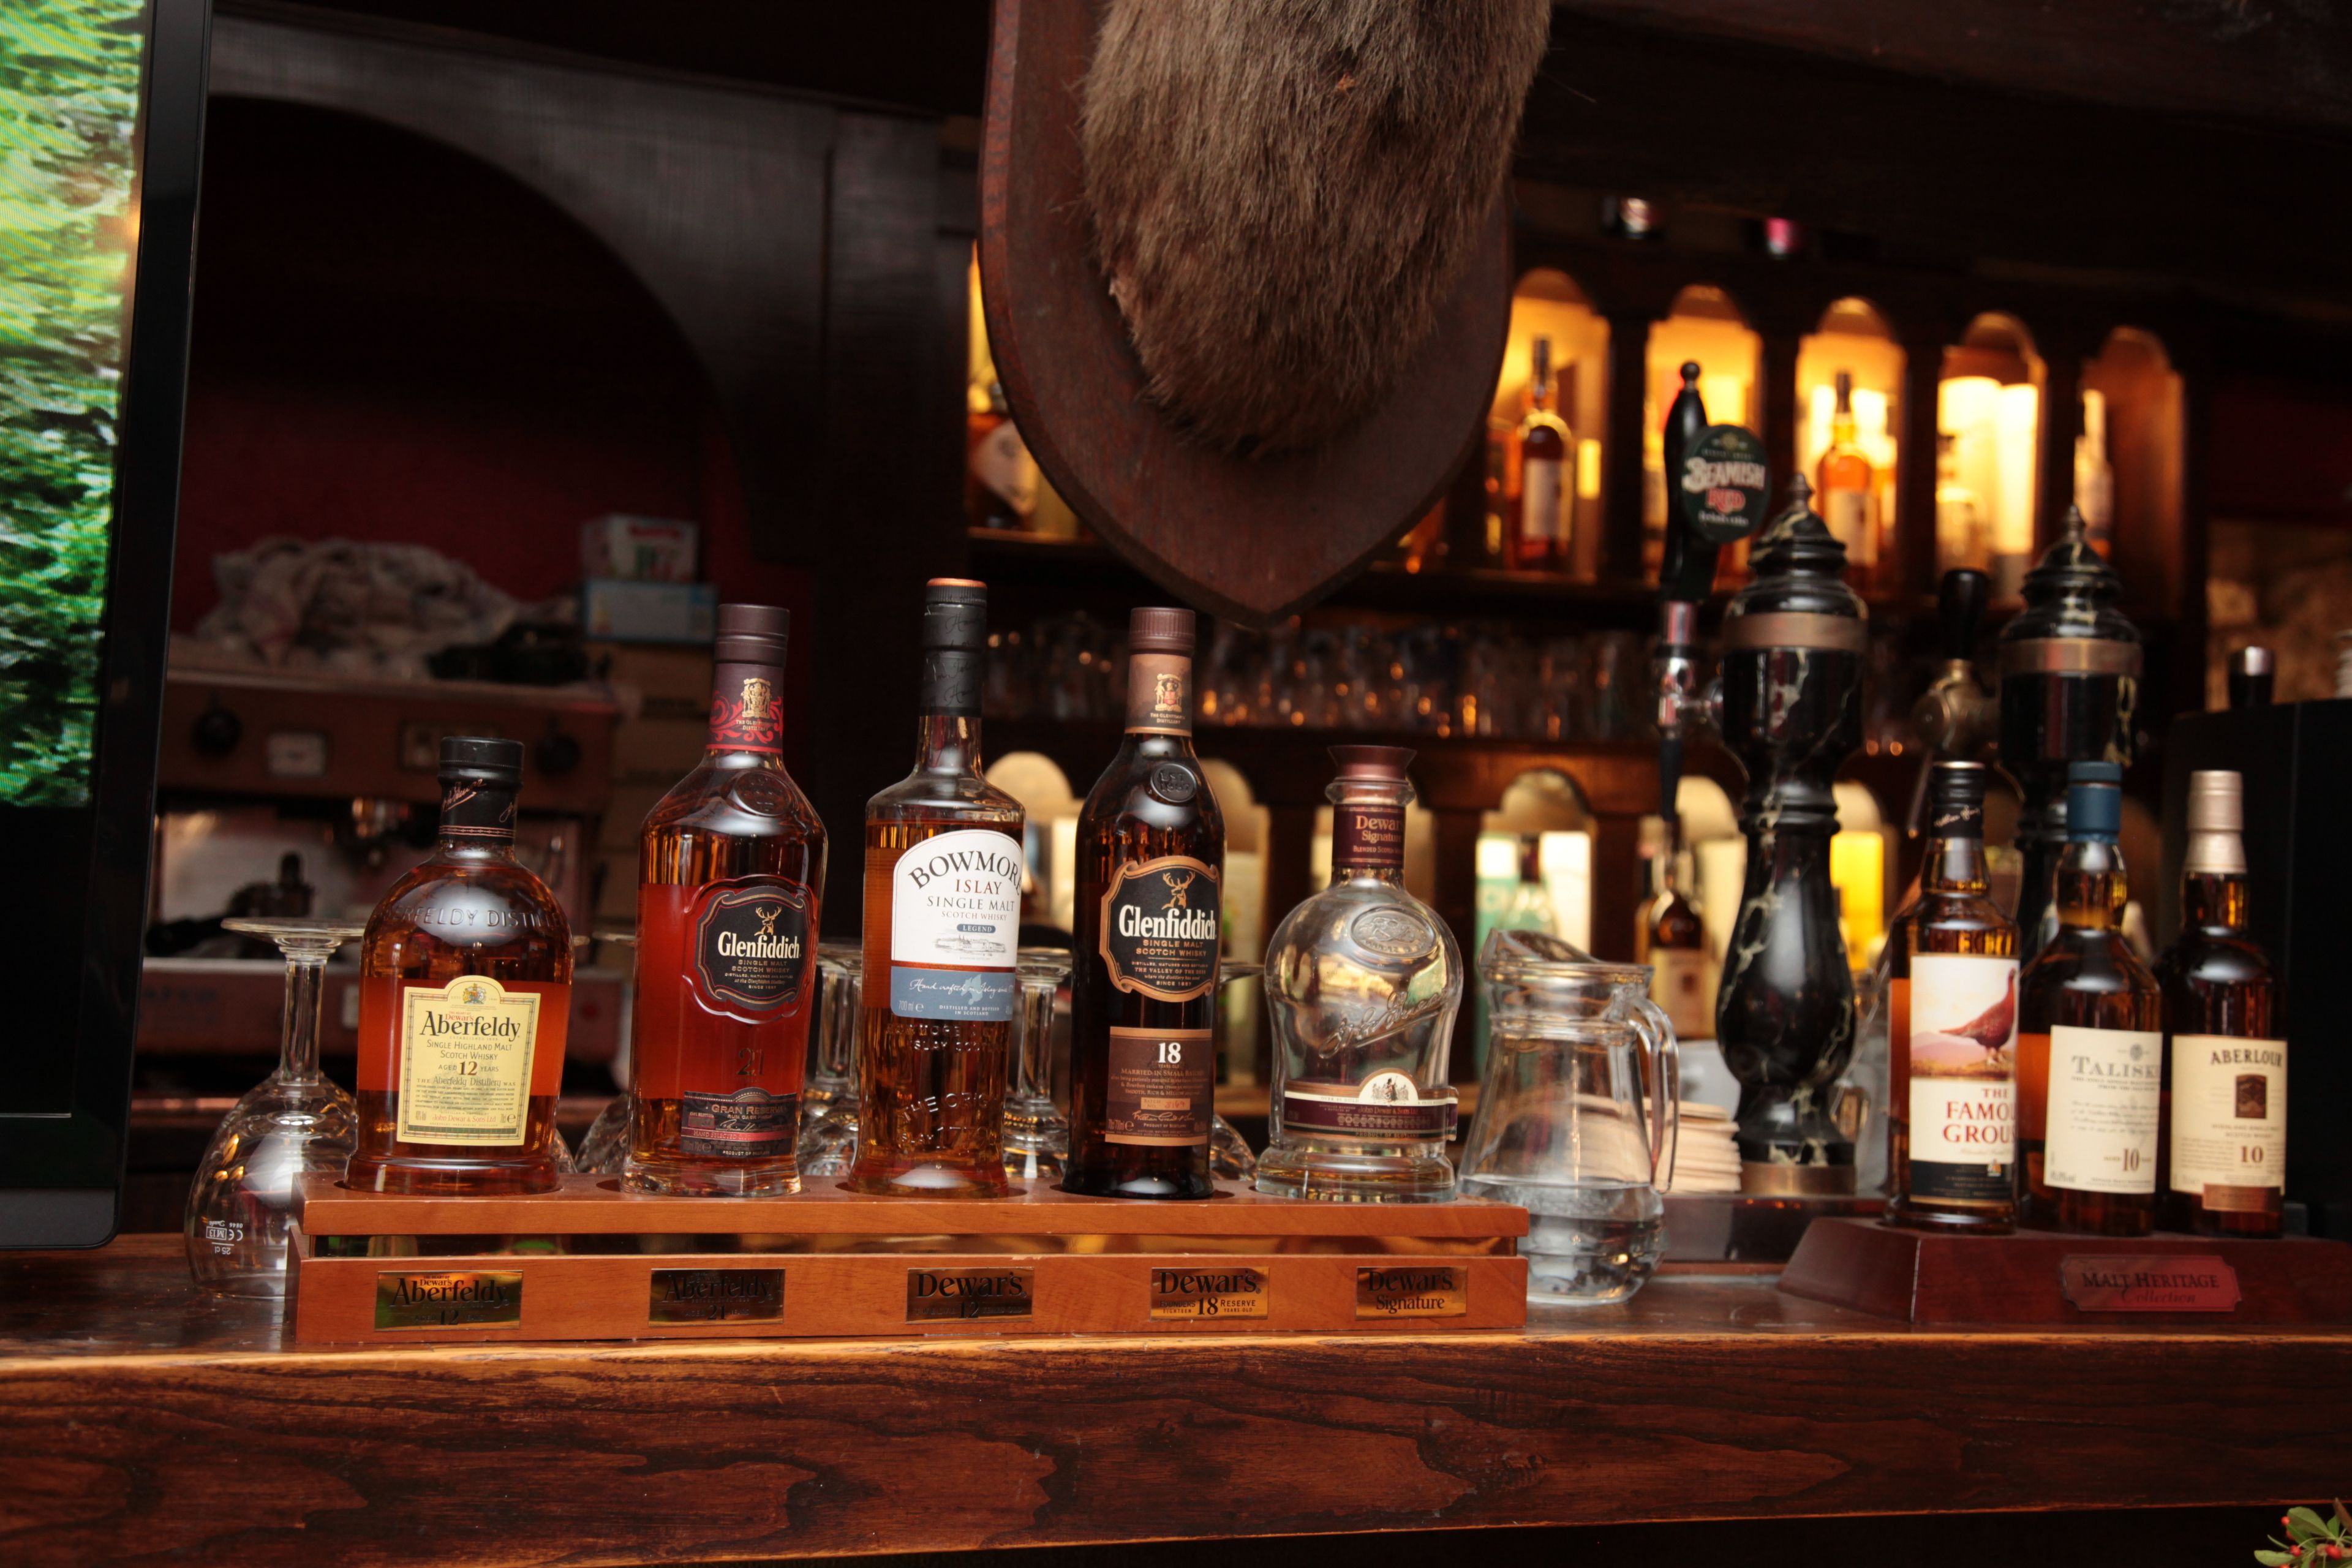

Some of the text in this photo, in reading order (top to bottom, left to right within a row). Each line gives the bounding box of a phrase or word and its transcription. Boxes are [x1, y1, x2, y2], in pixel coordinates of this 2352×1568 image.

[956, 879, 1002, 895] ISLAY
[927, 896, 1015, 912] SINGLE MALT
[941, 911, 978, 919] SCOTCH
[1119, 904, 1216, 940] Glenfiddich
[718, 931, 800, 959] Glenfiddich
[909, 978, 937, 992] Hand
[420, 1011, 521, 1042] Aberfeldy
[427, 1039, 451, 1049] SINGLE
[454, 1041, 492, 1051] HIGHLAND
[1158, 1042, 1182, 1064] 18
[440, 1050, 498, 1060] SCOTCH WHISKY
[736, 1047, 765, 1076] 21
[459, 1061, 478, 1076] 12
[433, 1076, 467, 1086] Aberfeldy
[470, 1078, 501, 1087] Distillery
[1983, 1088, 2009, 1098] THE
[711, 1104, 743, 1114] GRAN
[746, 1106, 783, 1114] RESERVA
[2122, 1148, 2140, 1172] 10
[2241, 1145, 2264, 1163] 10
[662, 1273, 770, 1303] Aberfeldy
[916, 1272, 1023, 1298] Dewar's
[1158, 1270, 1257, 1294] Dewar's
[1367, 1270, 1453, 1292] Dewar's
[2082, 1273, 2220, 1288] MALT HERITAGE
[389, 1278, 508, 1309] Aberfeldy
[707, 1304, 726, 1320] 21
[959, 1302, 979, 1318] 12
[1197, 1297, 1218, 1315] 18
[1376, 1295, 1445, 1314] Signature
[440, 1310, 459, 1325] 12
